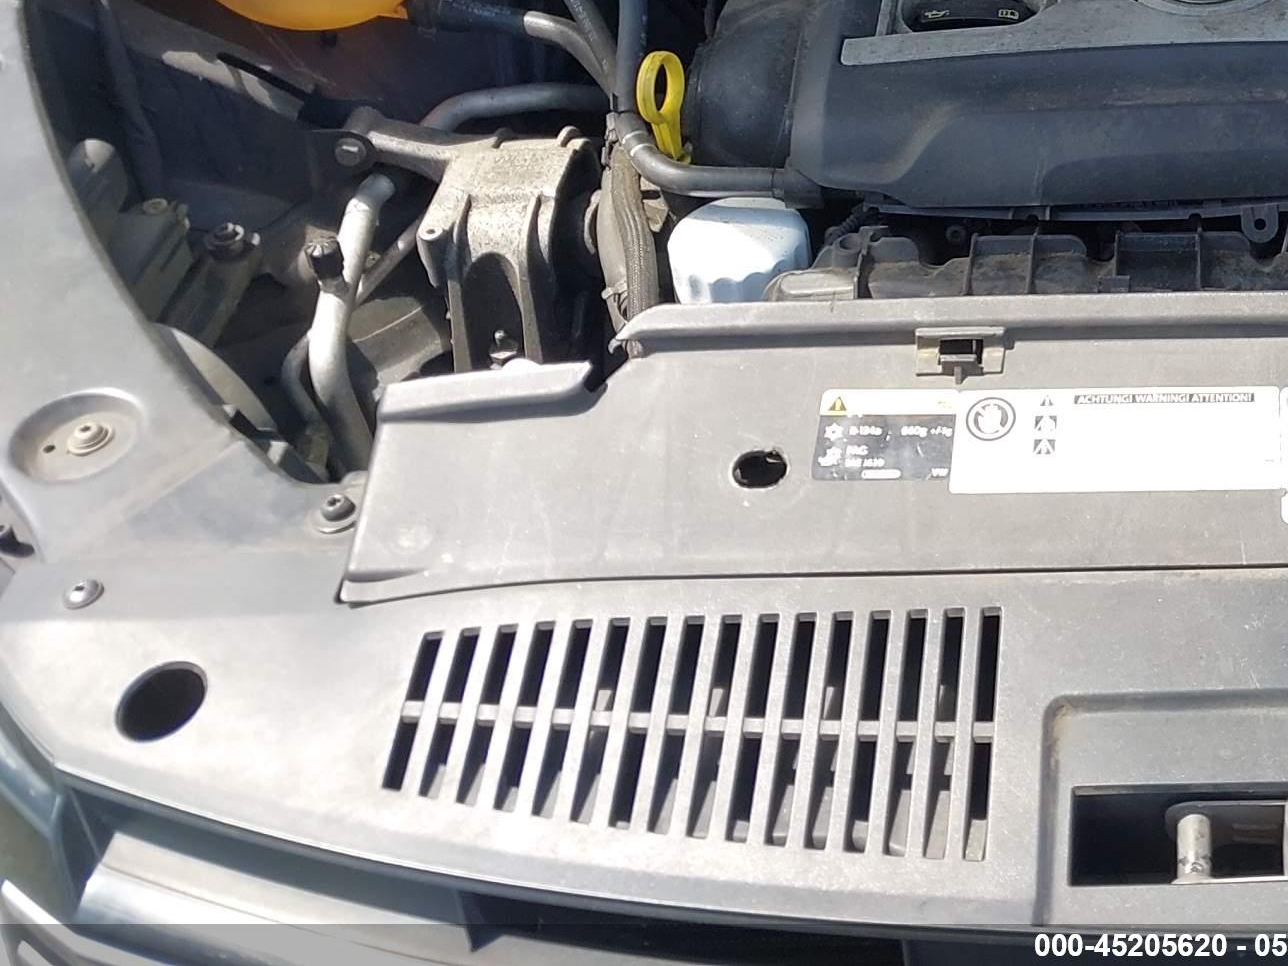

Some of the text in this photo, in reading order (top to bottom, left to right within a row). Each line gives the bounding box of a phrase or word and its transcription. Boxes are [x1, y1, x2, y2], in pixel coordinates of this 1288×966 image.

[1077, 393, 1252, 404] ACHTUNG! WARNING! ATTENTION!
